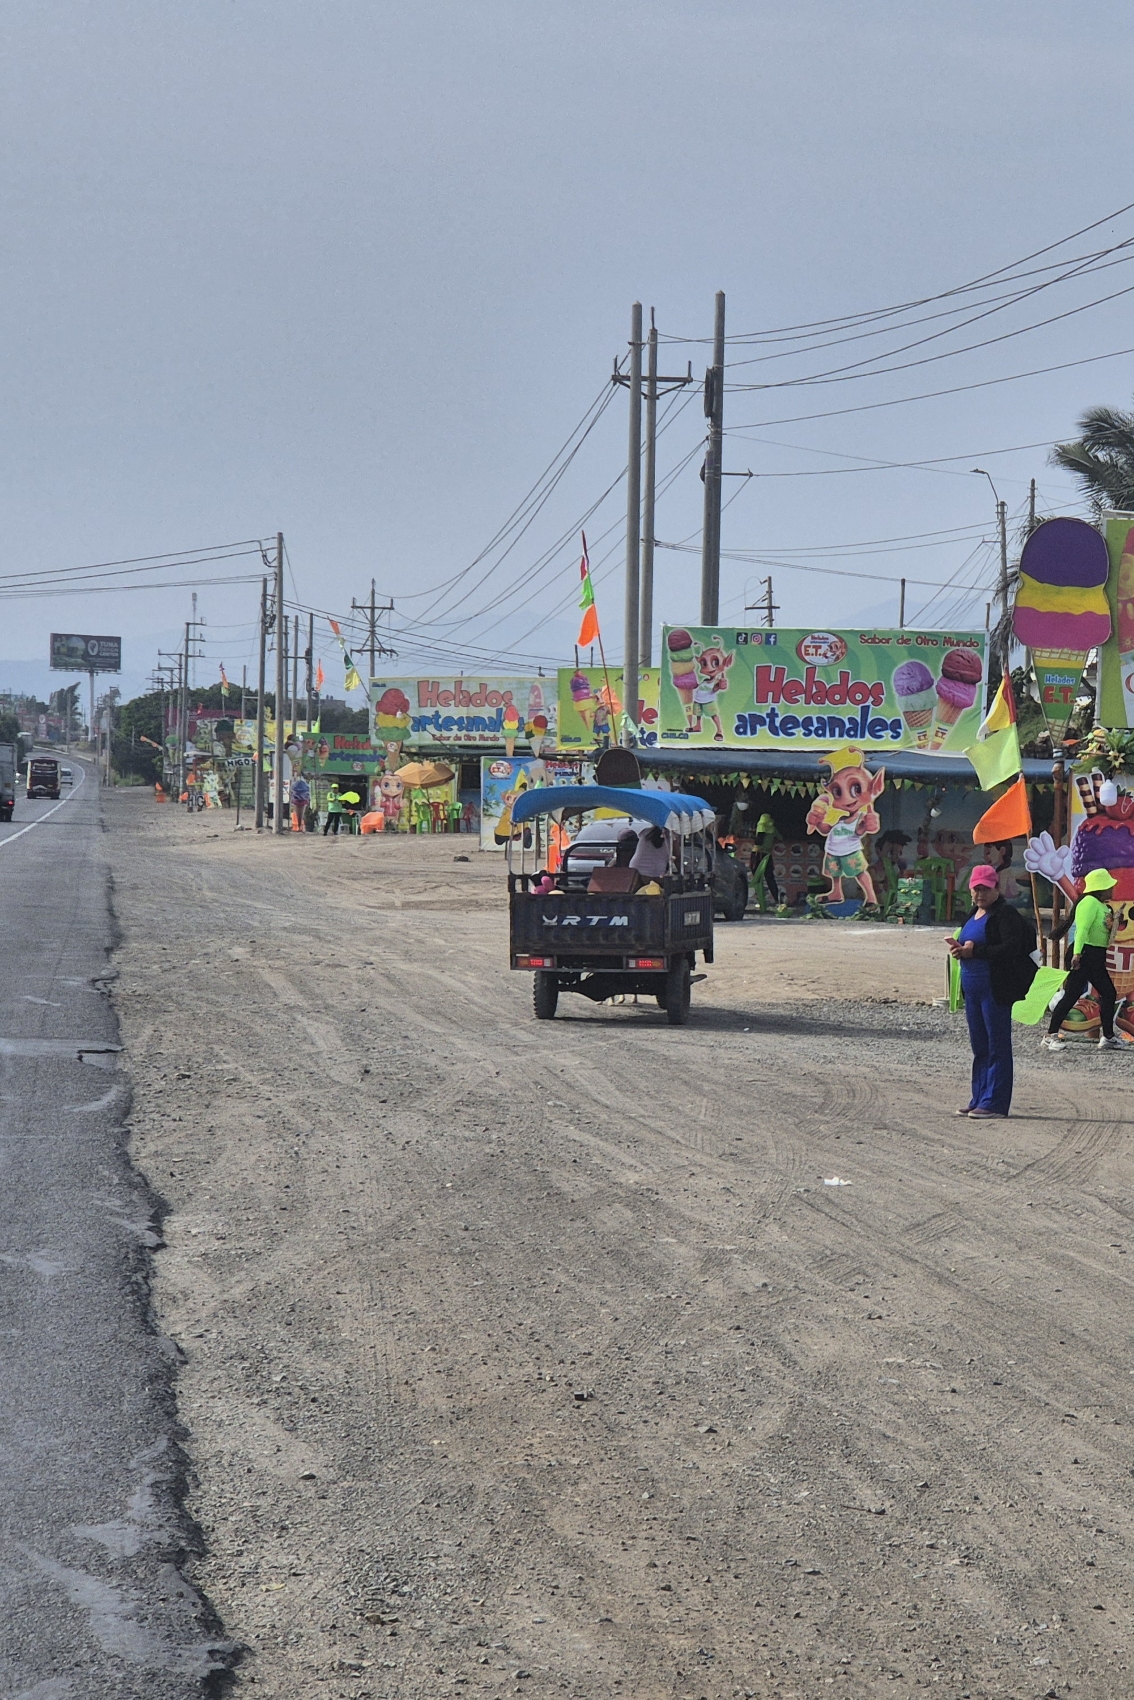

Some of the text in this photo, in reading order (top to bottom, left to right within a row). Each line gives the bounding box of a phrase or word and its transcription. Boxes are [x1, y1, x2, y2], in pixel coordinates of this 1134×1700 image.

[859, 634, 980, 648] Sabor de Otro Mundo
[755, 665, 885, 707] Helados
[1045, 674, 1075, 685] Helados
[417, 680, 514, 708] Helados
[1043, 686, 1076, 705] E.T.
[410, 708, 525, 733] artesanals
[734, 705, 903, 740] artesanales
[561, 915, 629, 926] RTM
